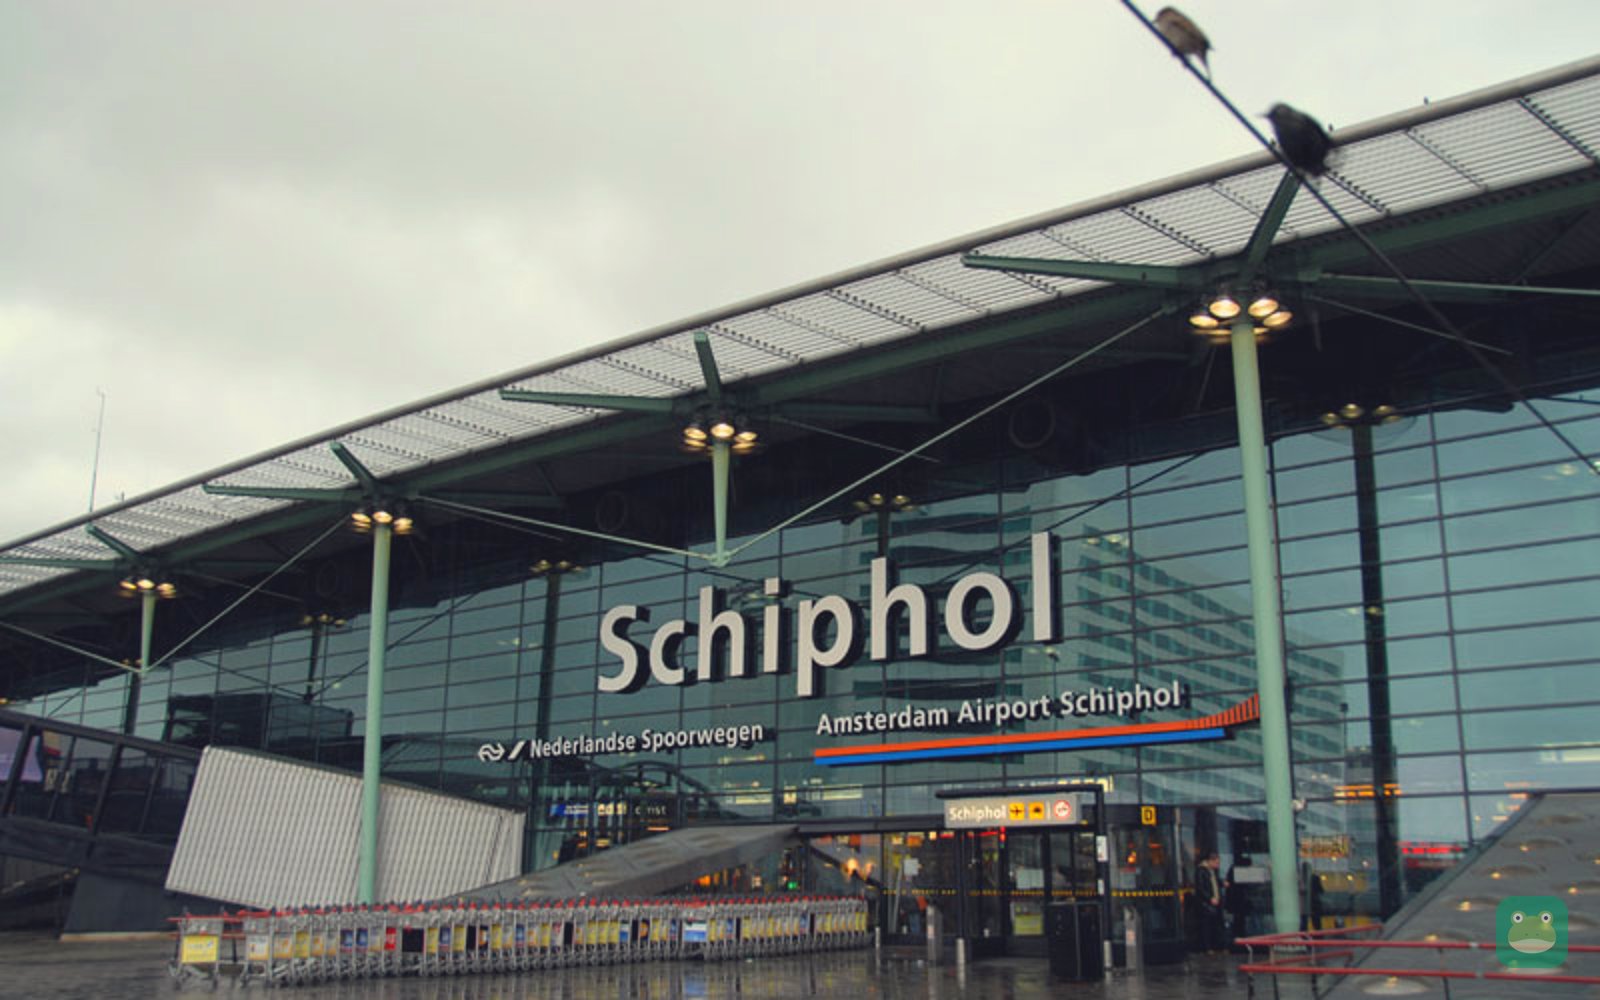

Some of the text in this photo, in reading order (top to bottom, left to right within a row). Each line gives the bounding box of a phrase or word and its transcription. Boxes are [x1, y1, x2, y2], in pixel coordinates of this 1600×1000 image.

[598, 531, 1058, 696] Schiphol
[815, 680, 1182, 736] Amsterdam Airport Schiphol
[529, 723, 764, 759] Nederlandse Spoorwegen
[949, 801, 1007, 823] Schiphol
